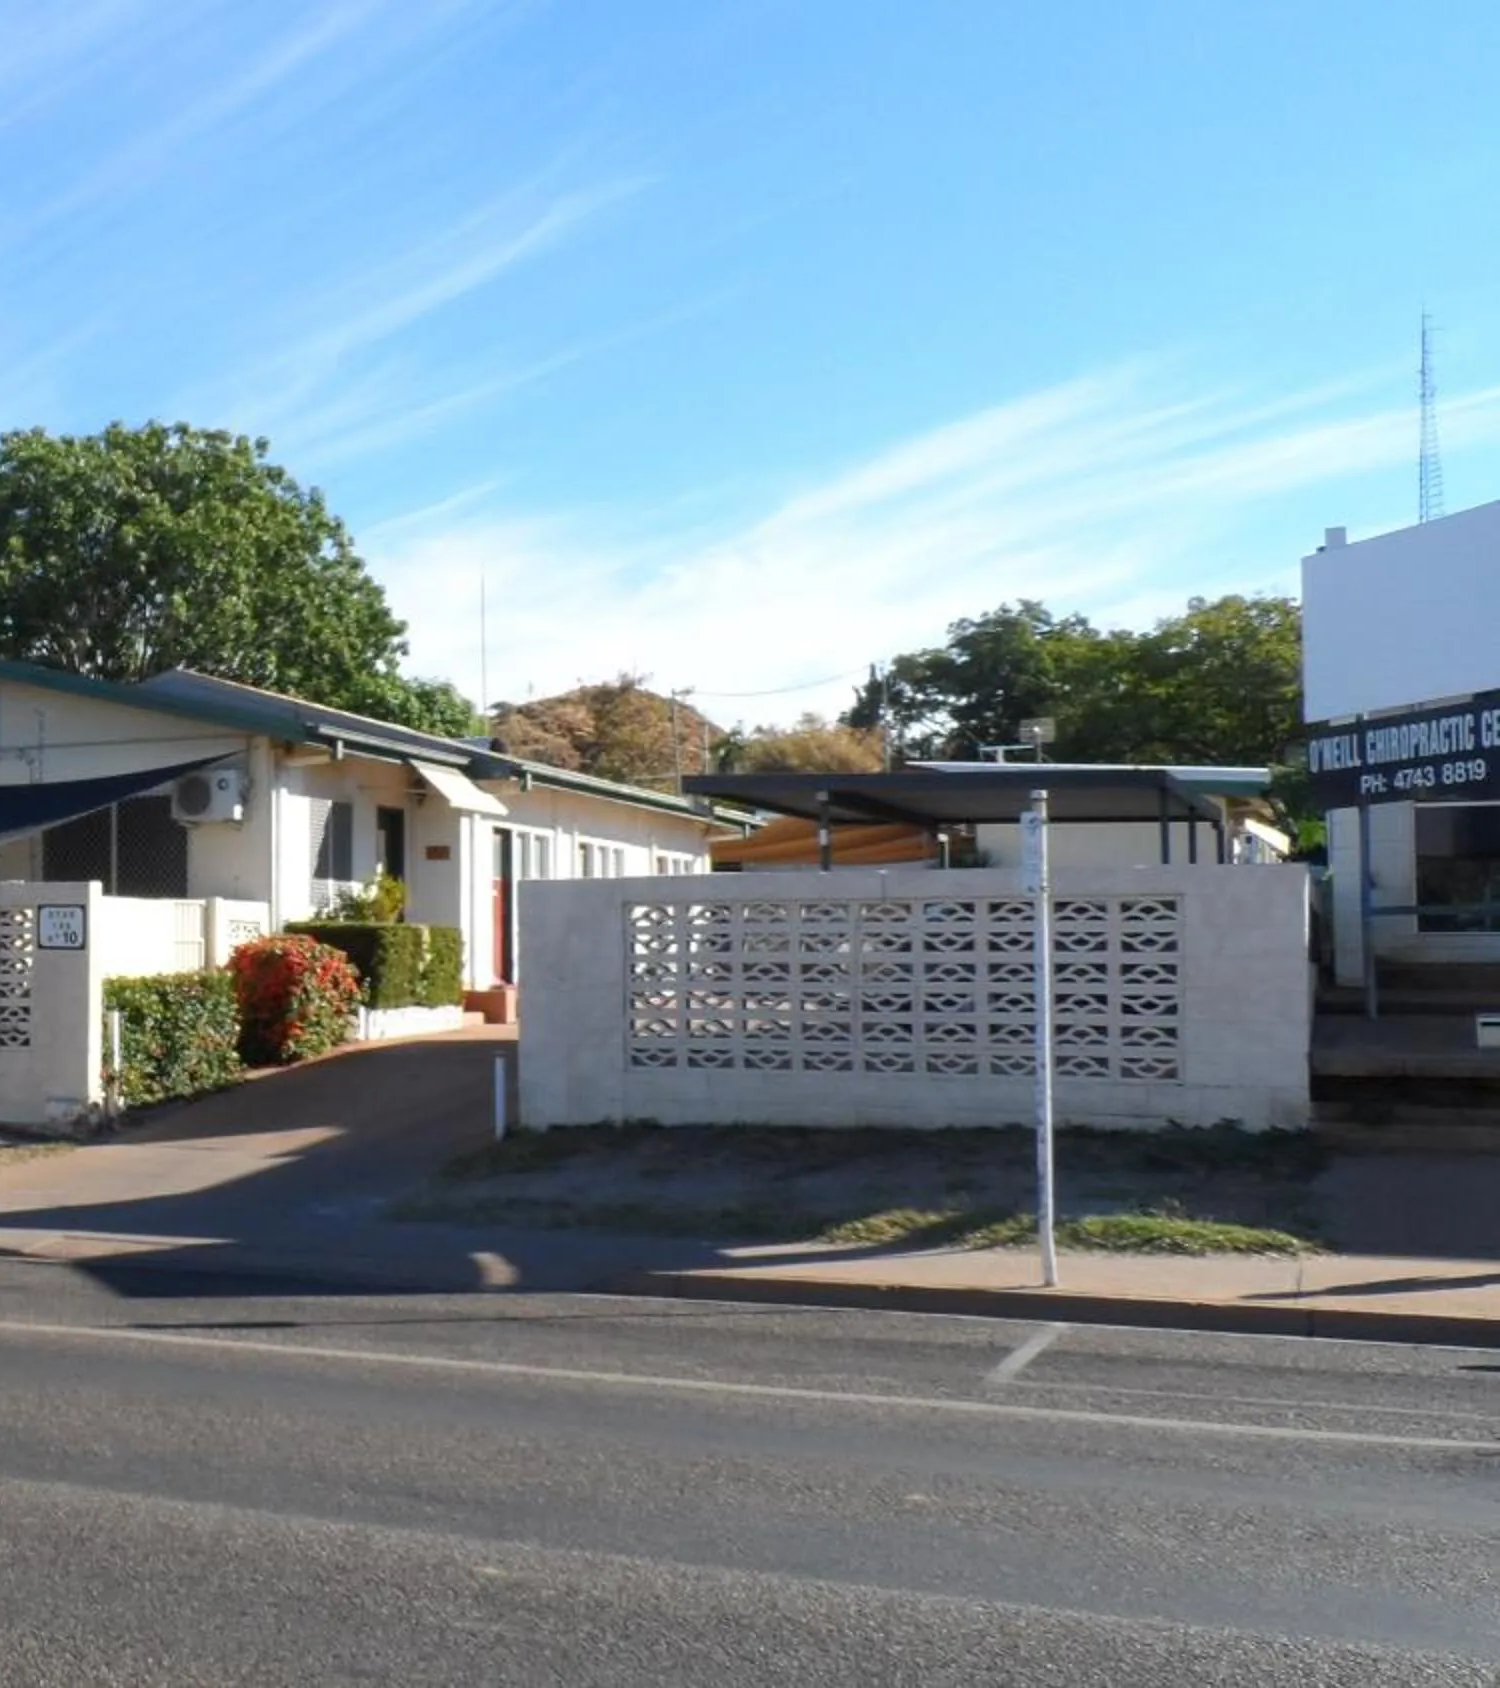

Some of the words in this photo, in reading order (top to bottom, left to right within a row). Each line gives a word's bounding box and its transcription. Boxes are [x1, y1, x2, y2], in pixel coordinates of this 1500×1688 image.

[1309, 734, 1361, 773] O'NEILL
[1366, 713, 1475, 765] CHIROPRACTIC
[1360, 773, 1387, 794] PH:
[1394, 765, 1435, 789] 4743
[1442, 759, 1486, 785] 8819
[63, 930, 78, 945] 10
